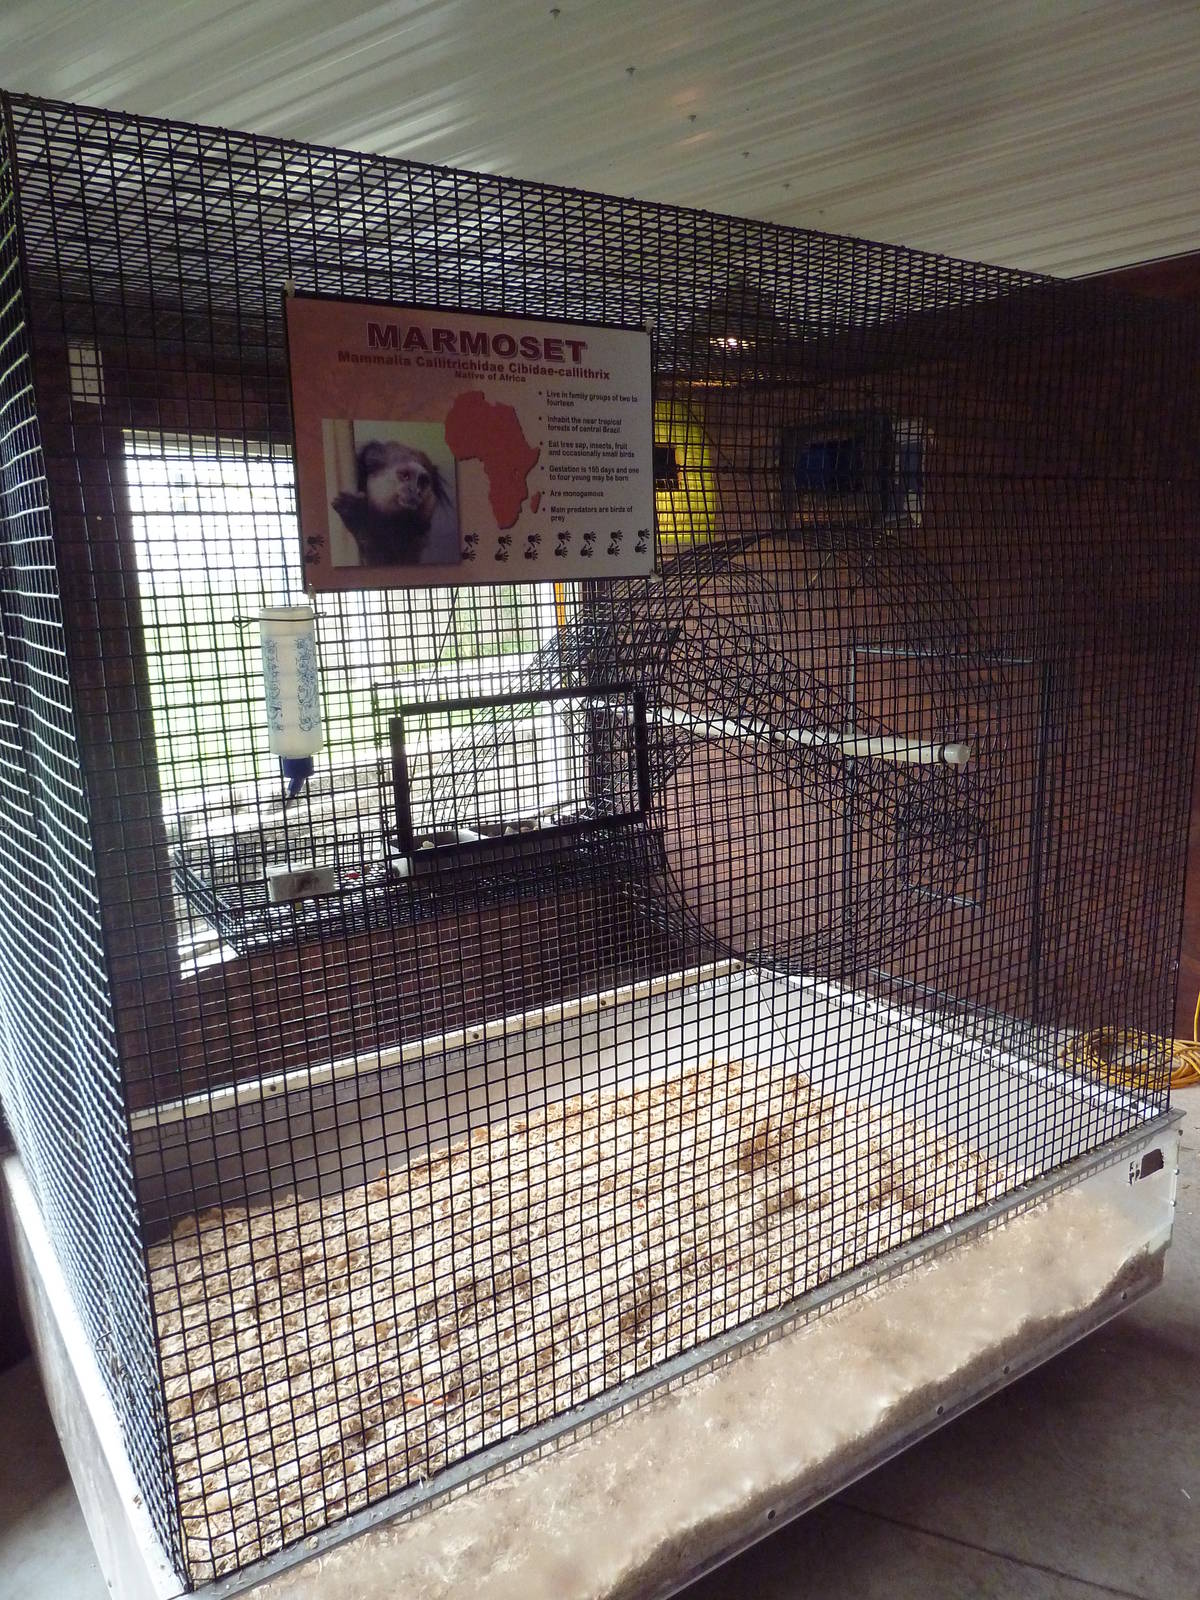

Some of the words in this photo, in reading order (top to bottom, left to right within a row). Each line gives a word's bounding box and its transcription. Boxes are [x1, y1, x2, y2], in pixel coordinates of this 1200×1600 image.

[367, 322, 587, 363] MARMOSET
[338, 351, 411, 366] Mammalia
[416, 356, 504, 372] Callitrichidae
[509, 363, 610, 380] Cibidae-callithrix
[455, 371, 485, 380] Native
[500, 374, 526, 382] Africa
[598, 419, 621, 427] tropical
[562, 450, 600, 458] occasionally
[549, 465, 581, 473] Gestation
[600, 467, 615, 475] days
